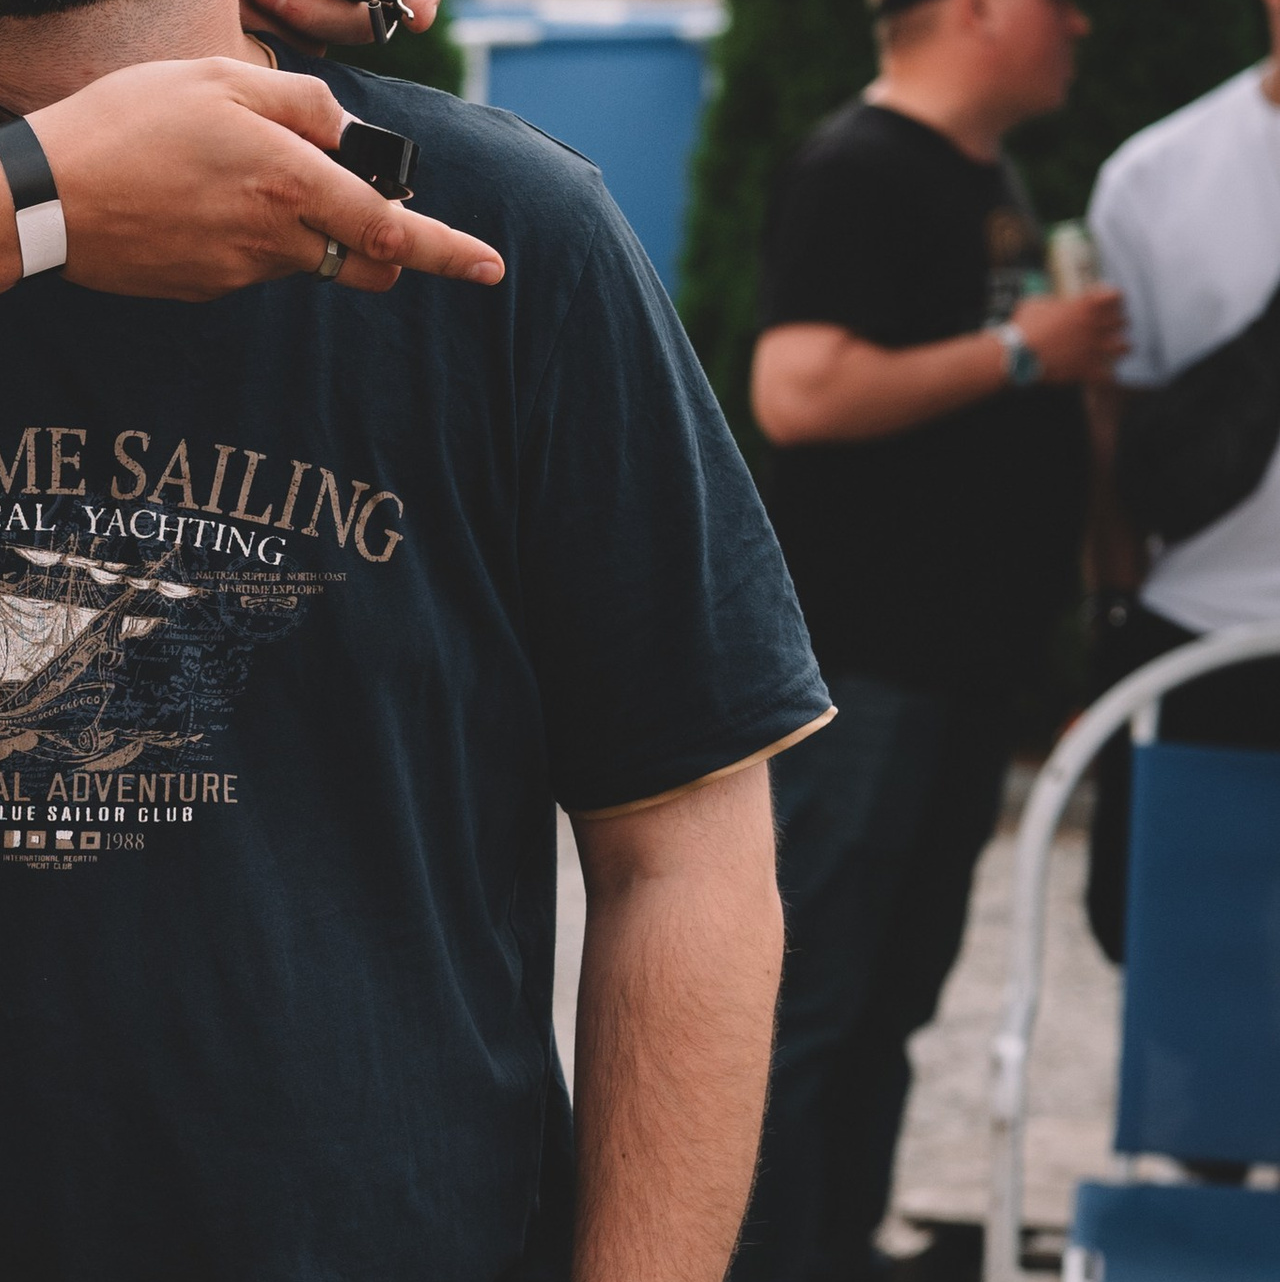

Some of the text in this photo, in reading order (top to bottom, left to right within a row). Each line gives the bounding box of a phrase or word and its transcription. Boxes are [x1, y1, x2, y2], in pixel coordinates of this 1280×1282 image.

[111, 429, 405, 563] SAILING
[84, 505, 287, 566] YACHTING
[195, 570, 240, 581] NAUTICAL
[218, 583, 324, 595] MARITIME EXPLORER
[46, 771, 239, 805] ADVENTURE
[46, 803, 125, 823] SAILOR
[137, 805, 194, 824] CLUB
[104, 832, 145, 851] 1988
[2, 854, 98, 863] INTERNATIONAL REGATTA
[26, 862, 50, 870] YACHT
